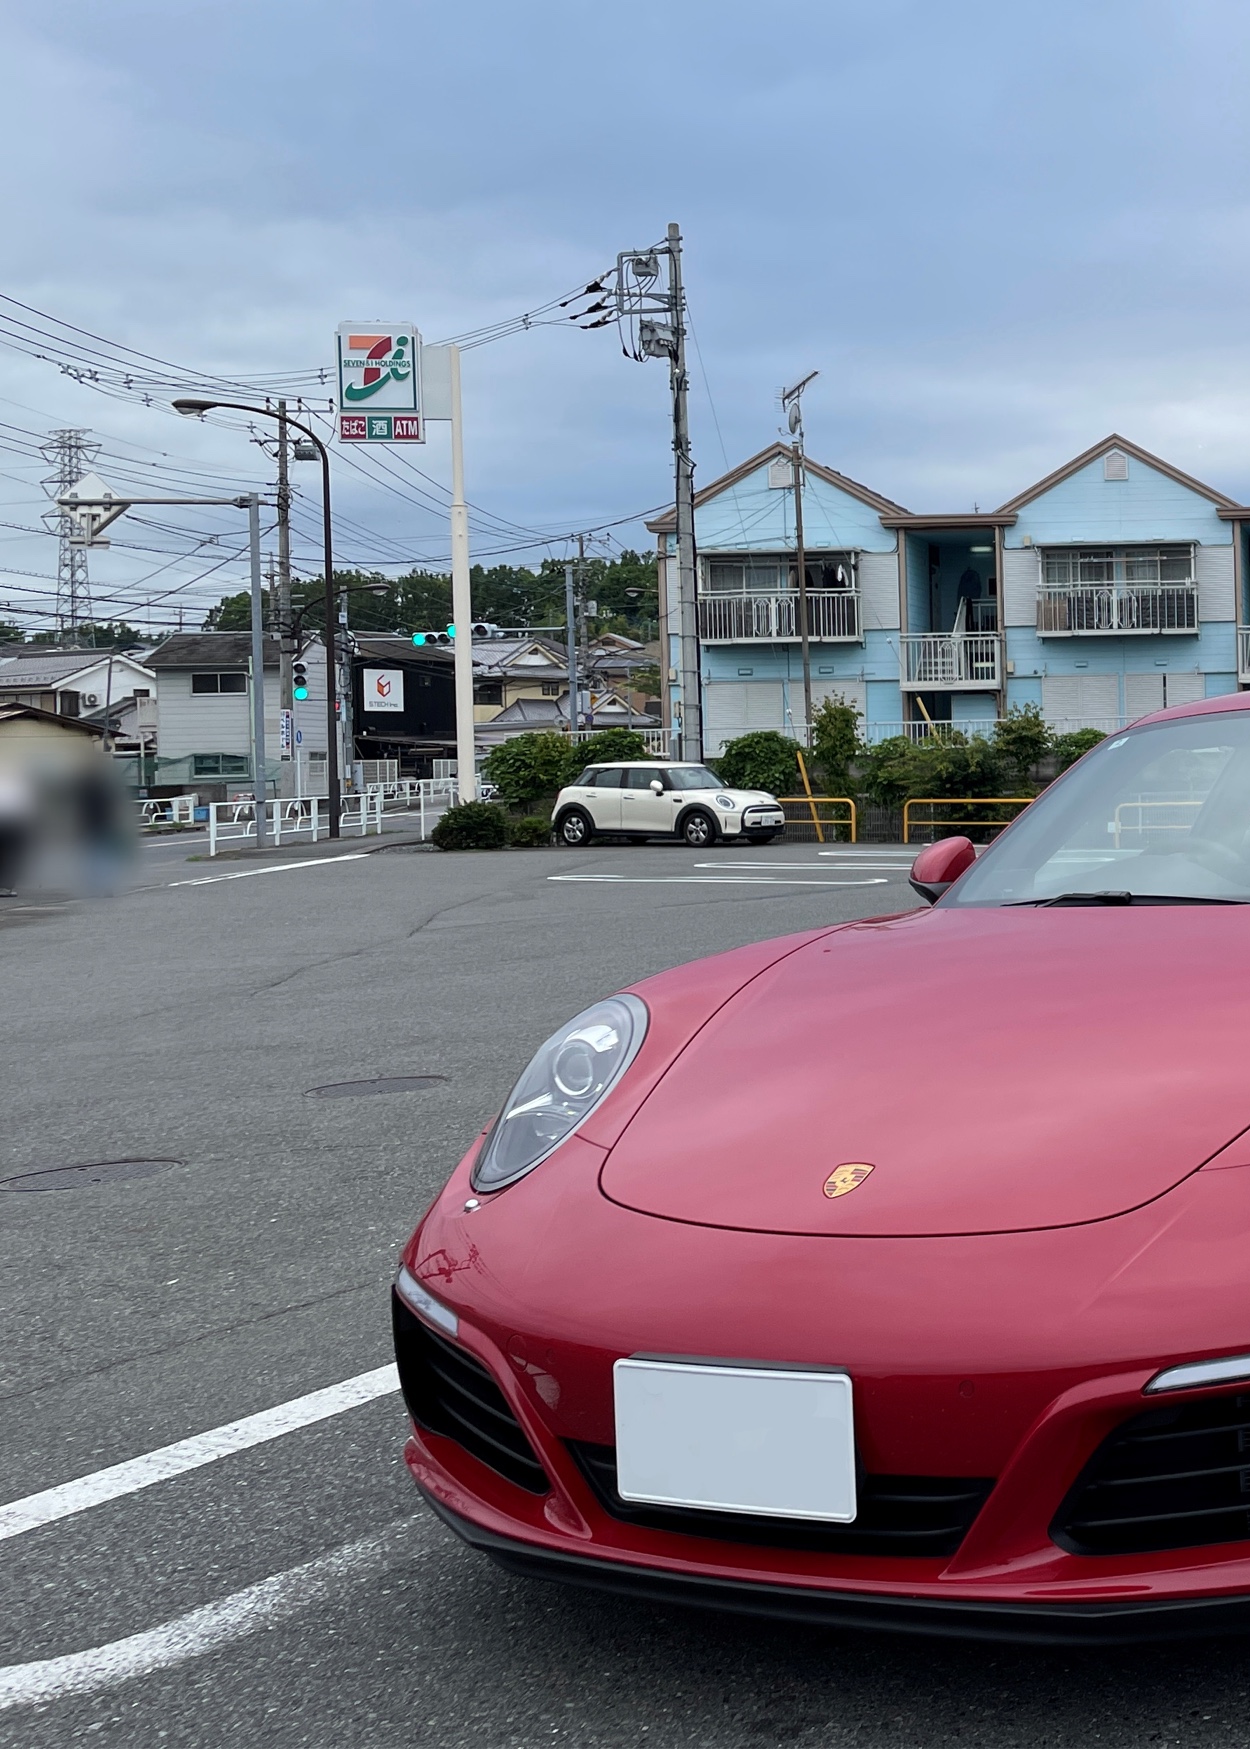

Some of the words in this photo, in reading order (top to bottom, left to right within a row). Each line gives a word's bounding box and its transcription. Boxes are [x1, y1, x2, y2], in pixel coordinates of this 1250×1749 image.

[375, 360, 411, 368] HOLDINGS
[341, 420, 366, 435] たばこ
[372, 420, 387, 435] 酒
[395, 420, 418, 436] ATM
